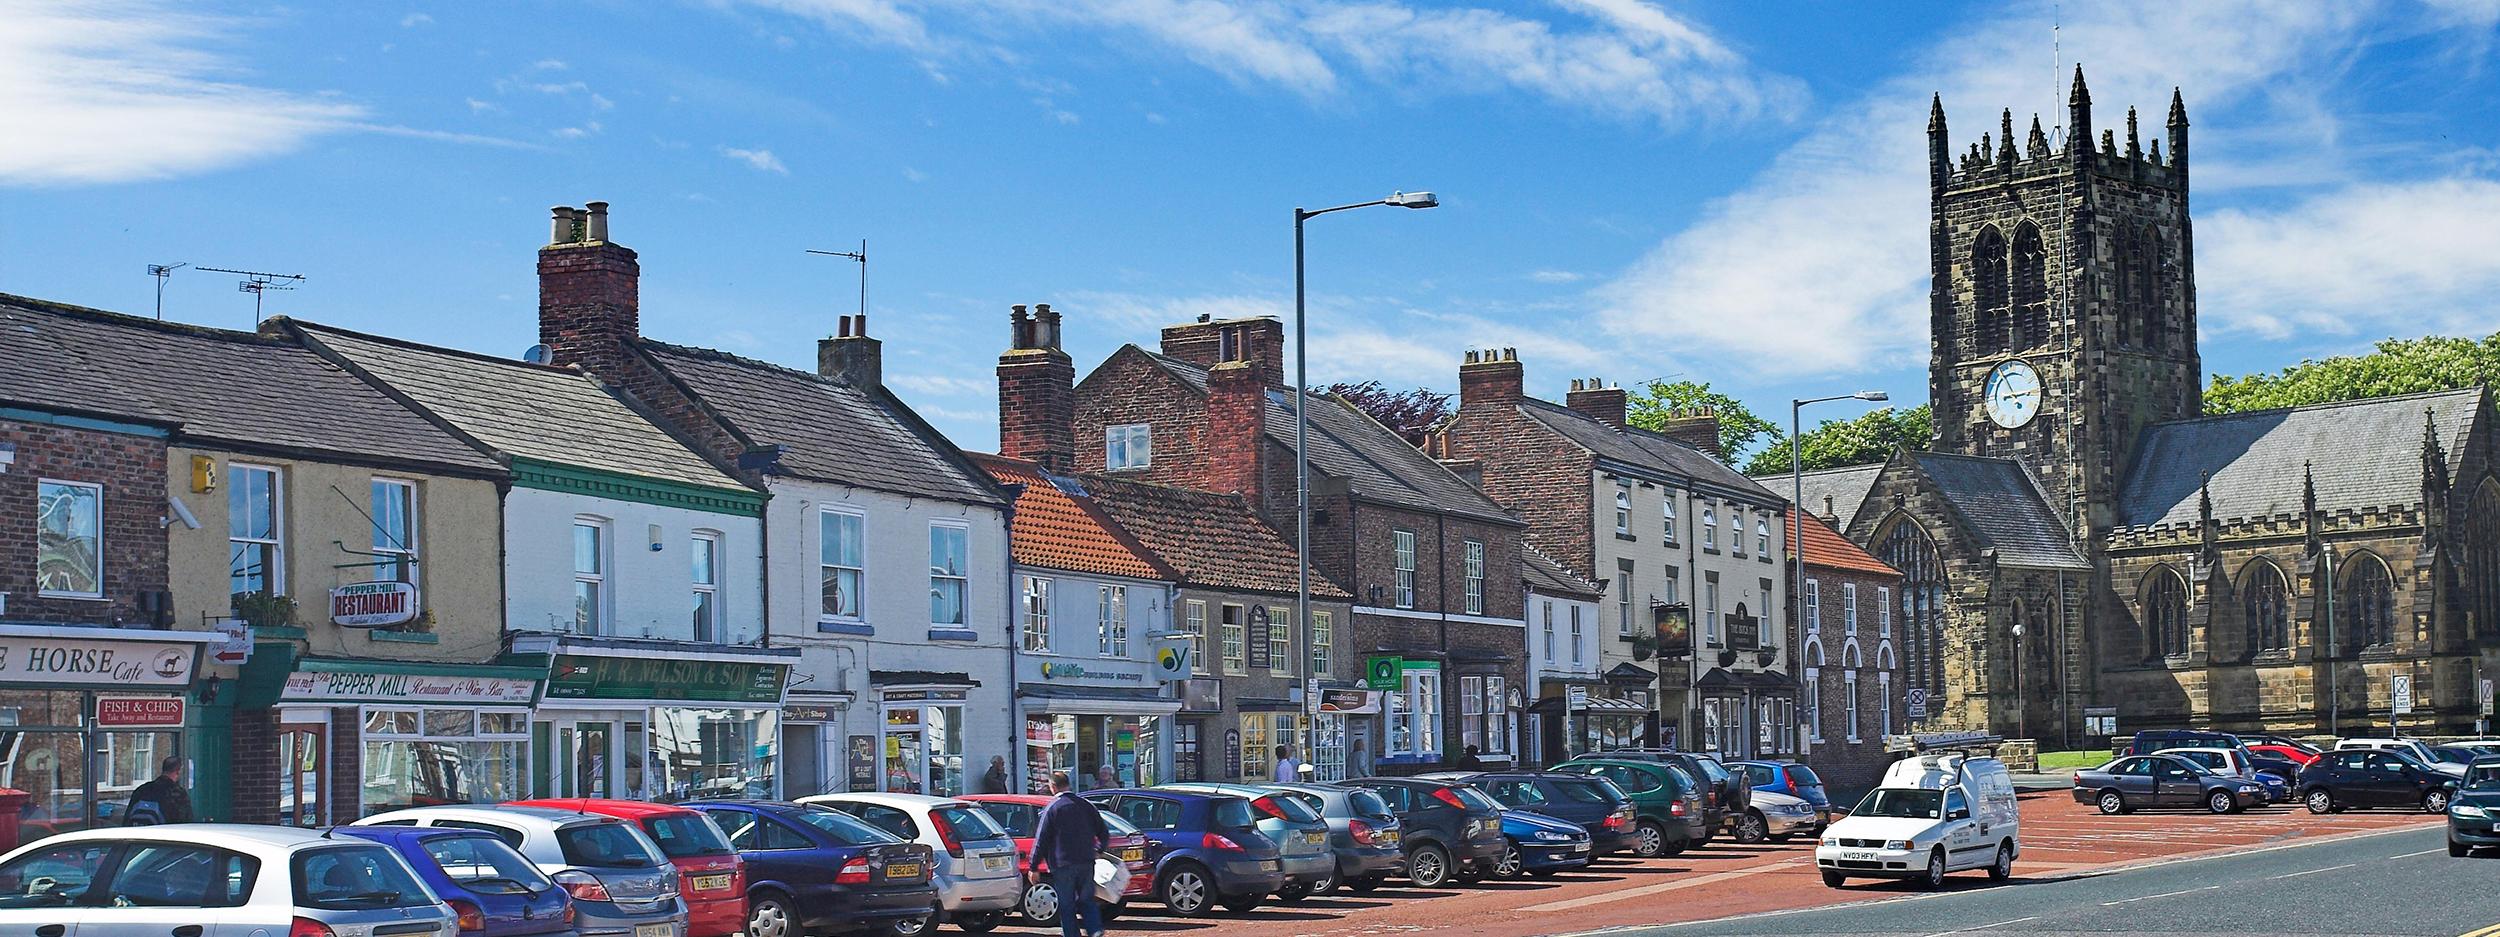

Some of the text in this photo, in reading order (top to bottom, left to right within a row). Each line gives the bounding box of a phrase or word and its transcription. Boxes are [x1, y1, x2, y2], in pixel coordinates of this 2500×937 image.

[344, 584, 396, 594] PEPPER MILL
[335, 592, 406, 616] RESTAURANT
[26, 648, 114, 673] HORSE
[113, 662, 144, 683] Cafe
[639, 660, 701, 684] NELSON
[704, 665, 716, 684] &
[720, 664, 751, 690] SON
[328, 674, 375, 694] PEPPER
[377, 675, 408, 696] MILL
[409, 679, 453, 695] Restaurant
[465, 680, 483, 696] Wine
[485, 681, 504, 696] Bar
[104, 701, 179, 713] FISH & CHIPS
[121, 714, 135, 722] Away
